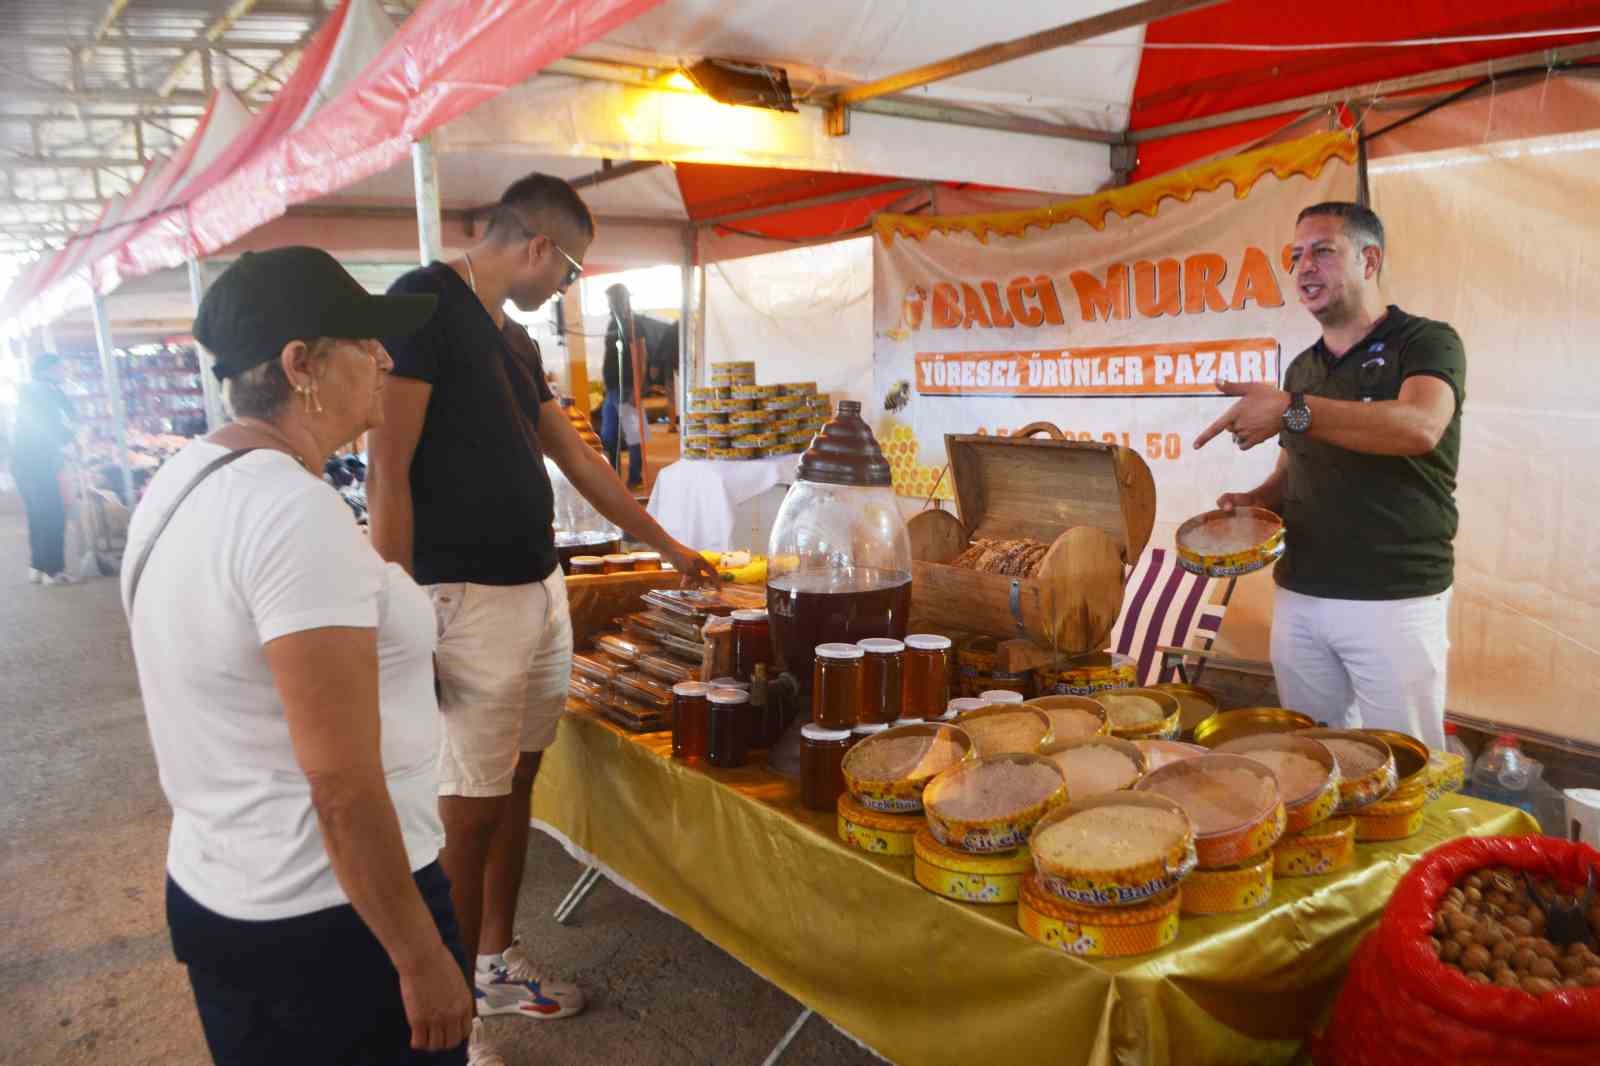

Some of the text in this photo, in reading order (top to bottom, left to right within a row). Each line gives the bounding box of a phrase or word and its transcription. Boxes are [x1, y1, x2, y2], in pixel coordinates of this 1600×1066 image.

[1069, 244, 1297, 322] MURA
[921, 350, 1280, 387] YÖRESEL ÜRÜNLER PAZARI
[1146, 431, 1182, 460] 50
